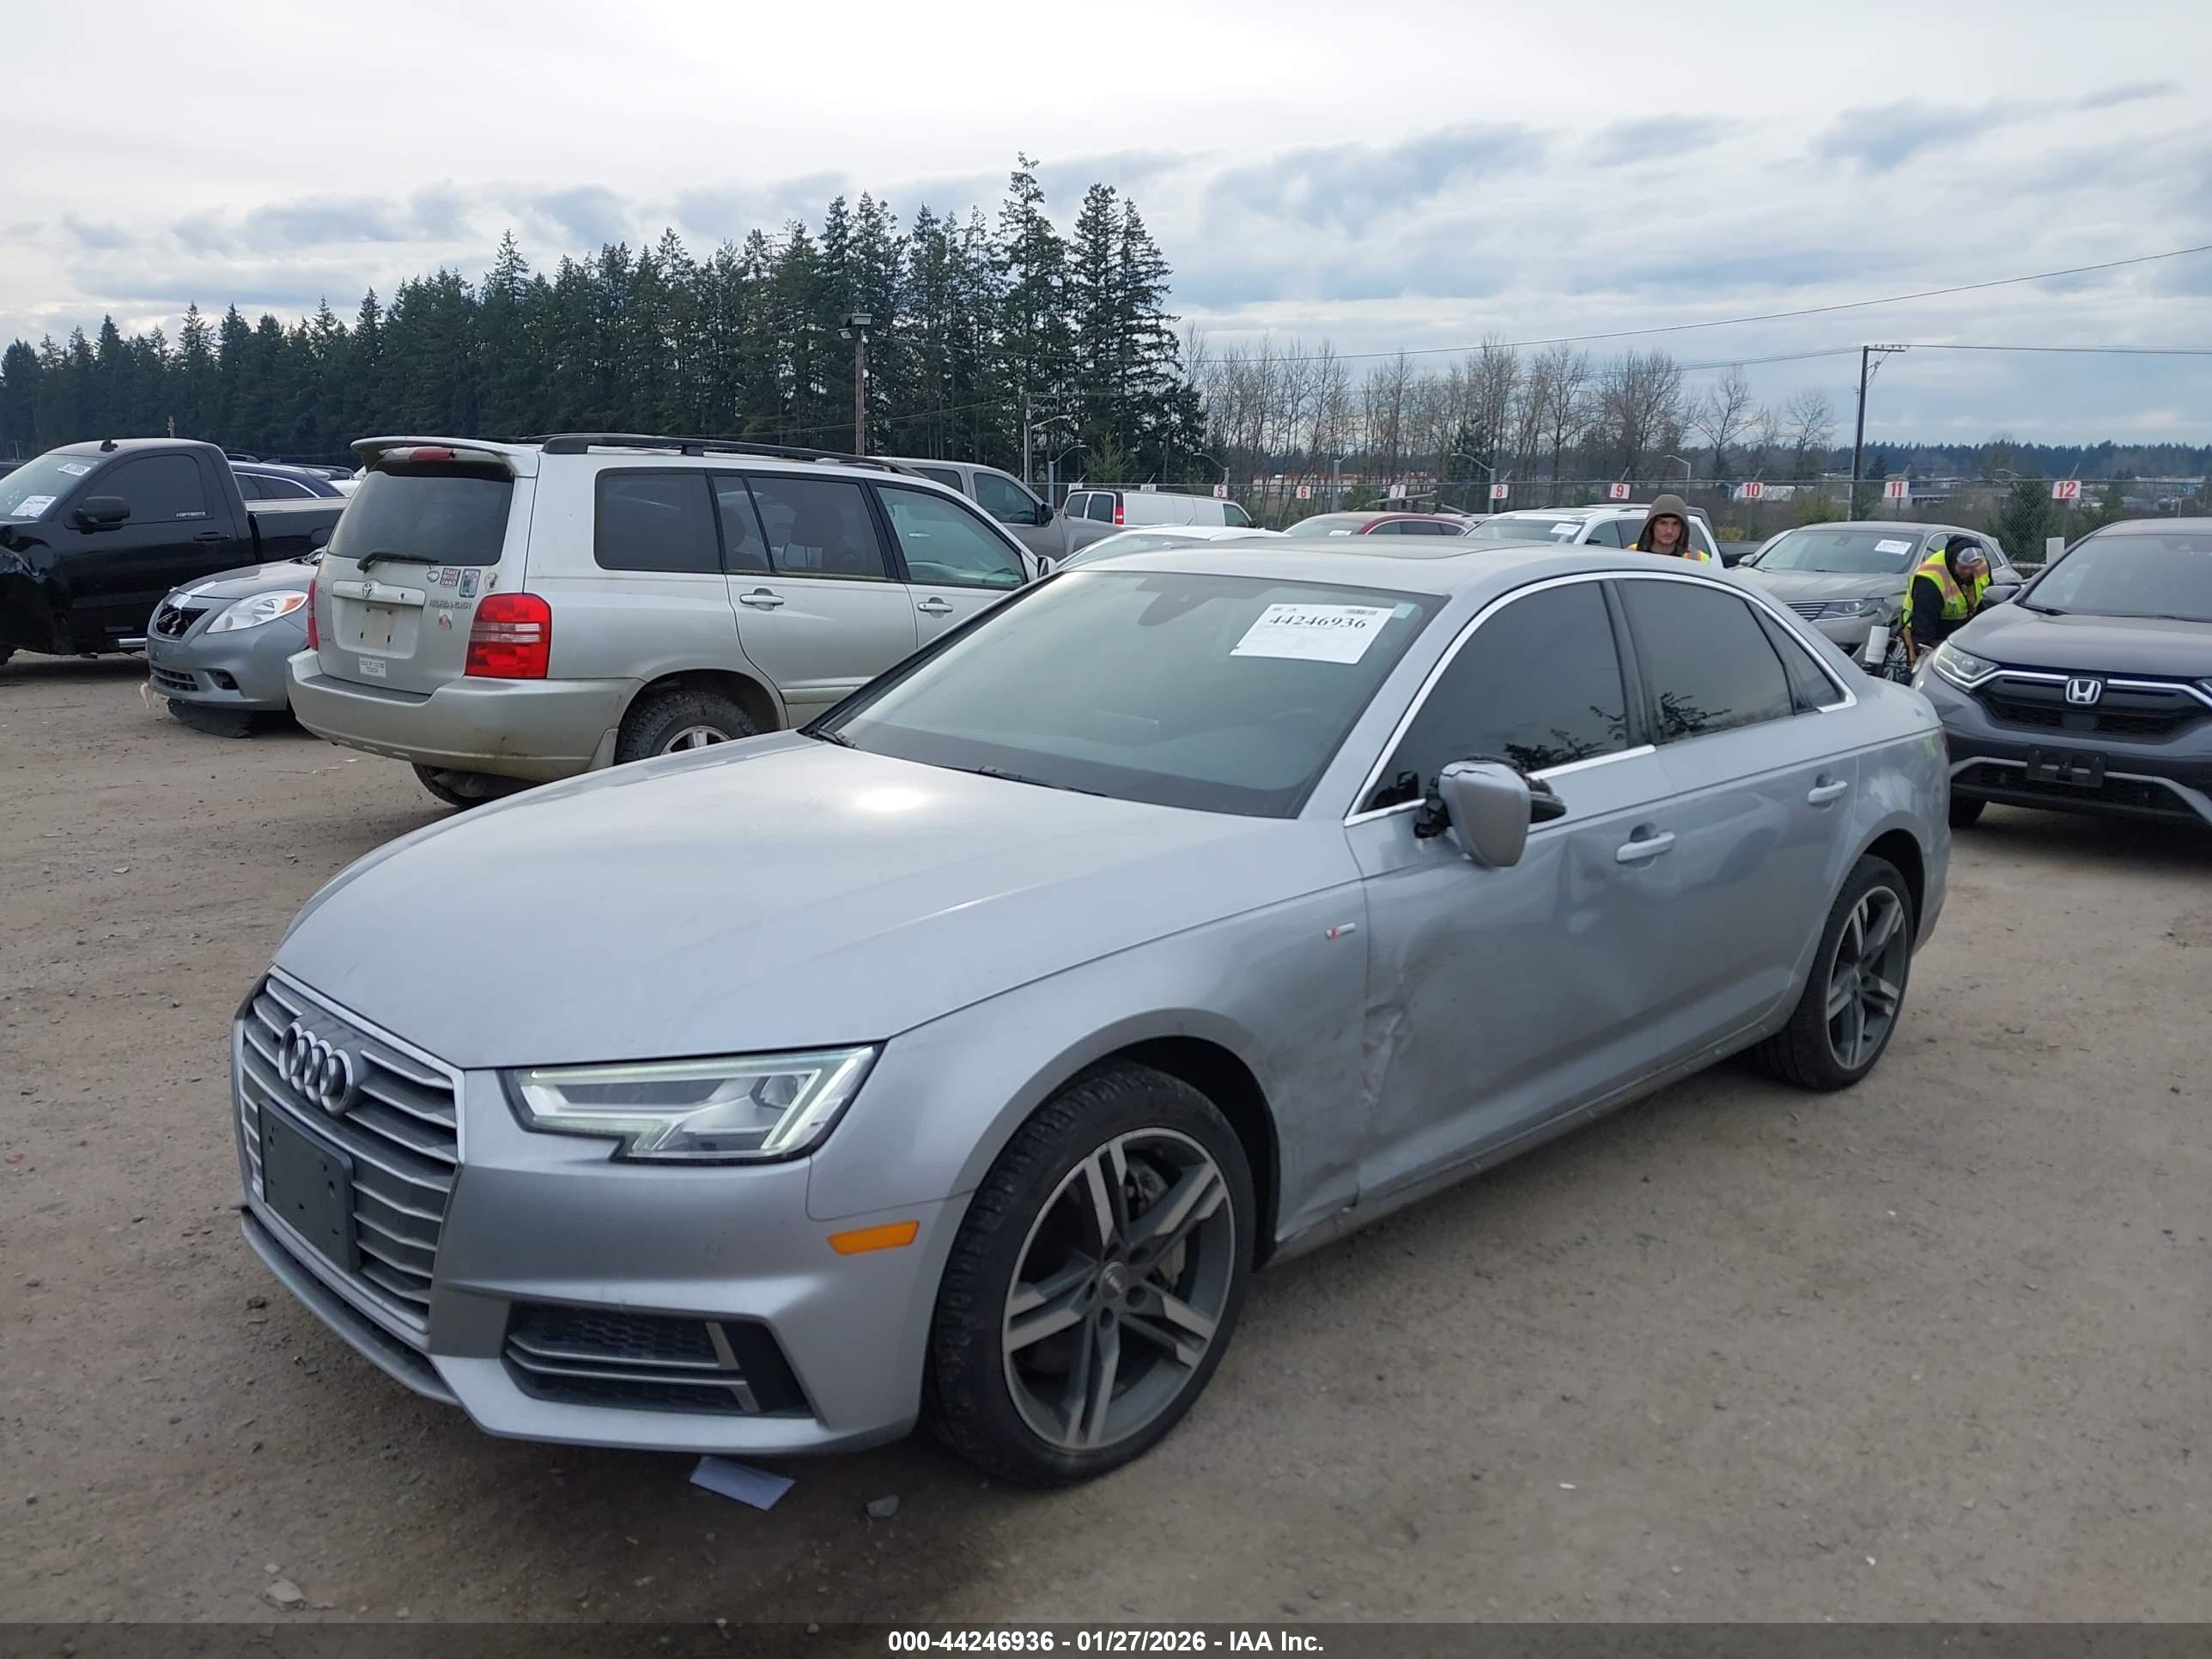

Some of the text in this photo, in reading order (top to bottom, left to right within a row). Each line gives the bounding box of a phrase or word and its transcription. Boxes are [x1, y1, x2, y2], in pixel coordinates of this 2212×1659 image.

[1217, 485, 1224, 497] 5
[1300, 486, 1307, 498] 6
[1395, 486, 1401, 497] 7
[1496, 485, 1503, 498] 8
[1615, 484, 1624, 498] 9
[1745, 483, 1760, 497] 10
[1891, 482, 1903, 497] 11
[2058, 481, 2076, 498] 12
[1268, 614, 1368, 629] 44246936
